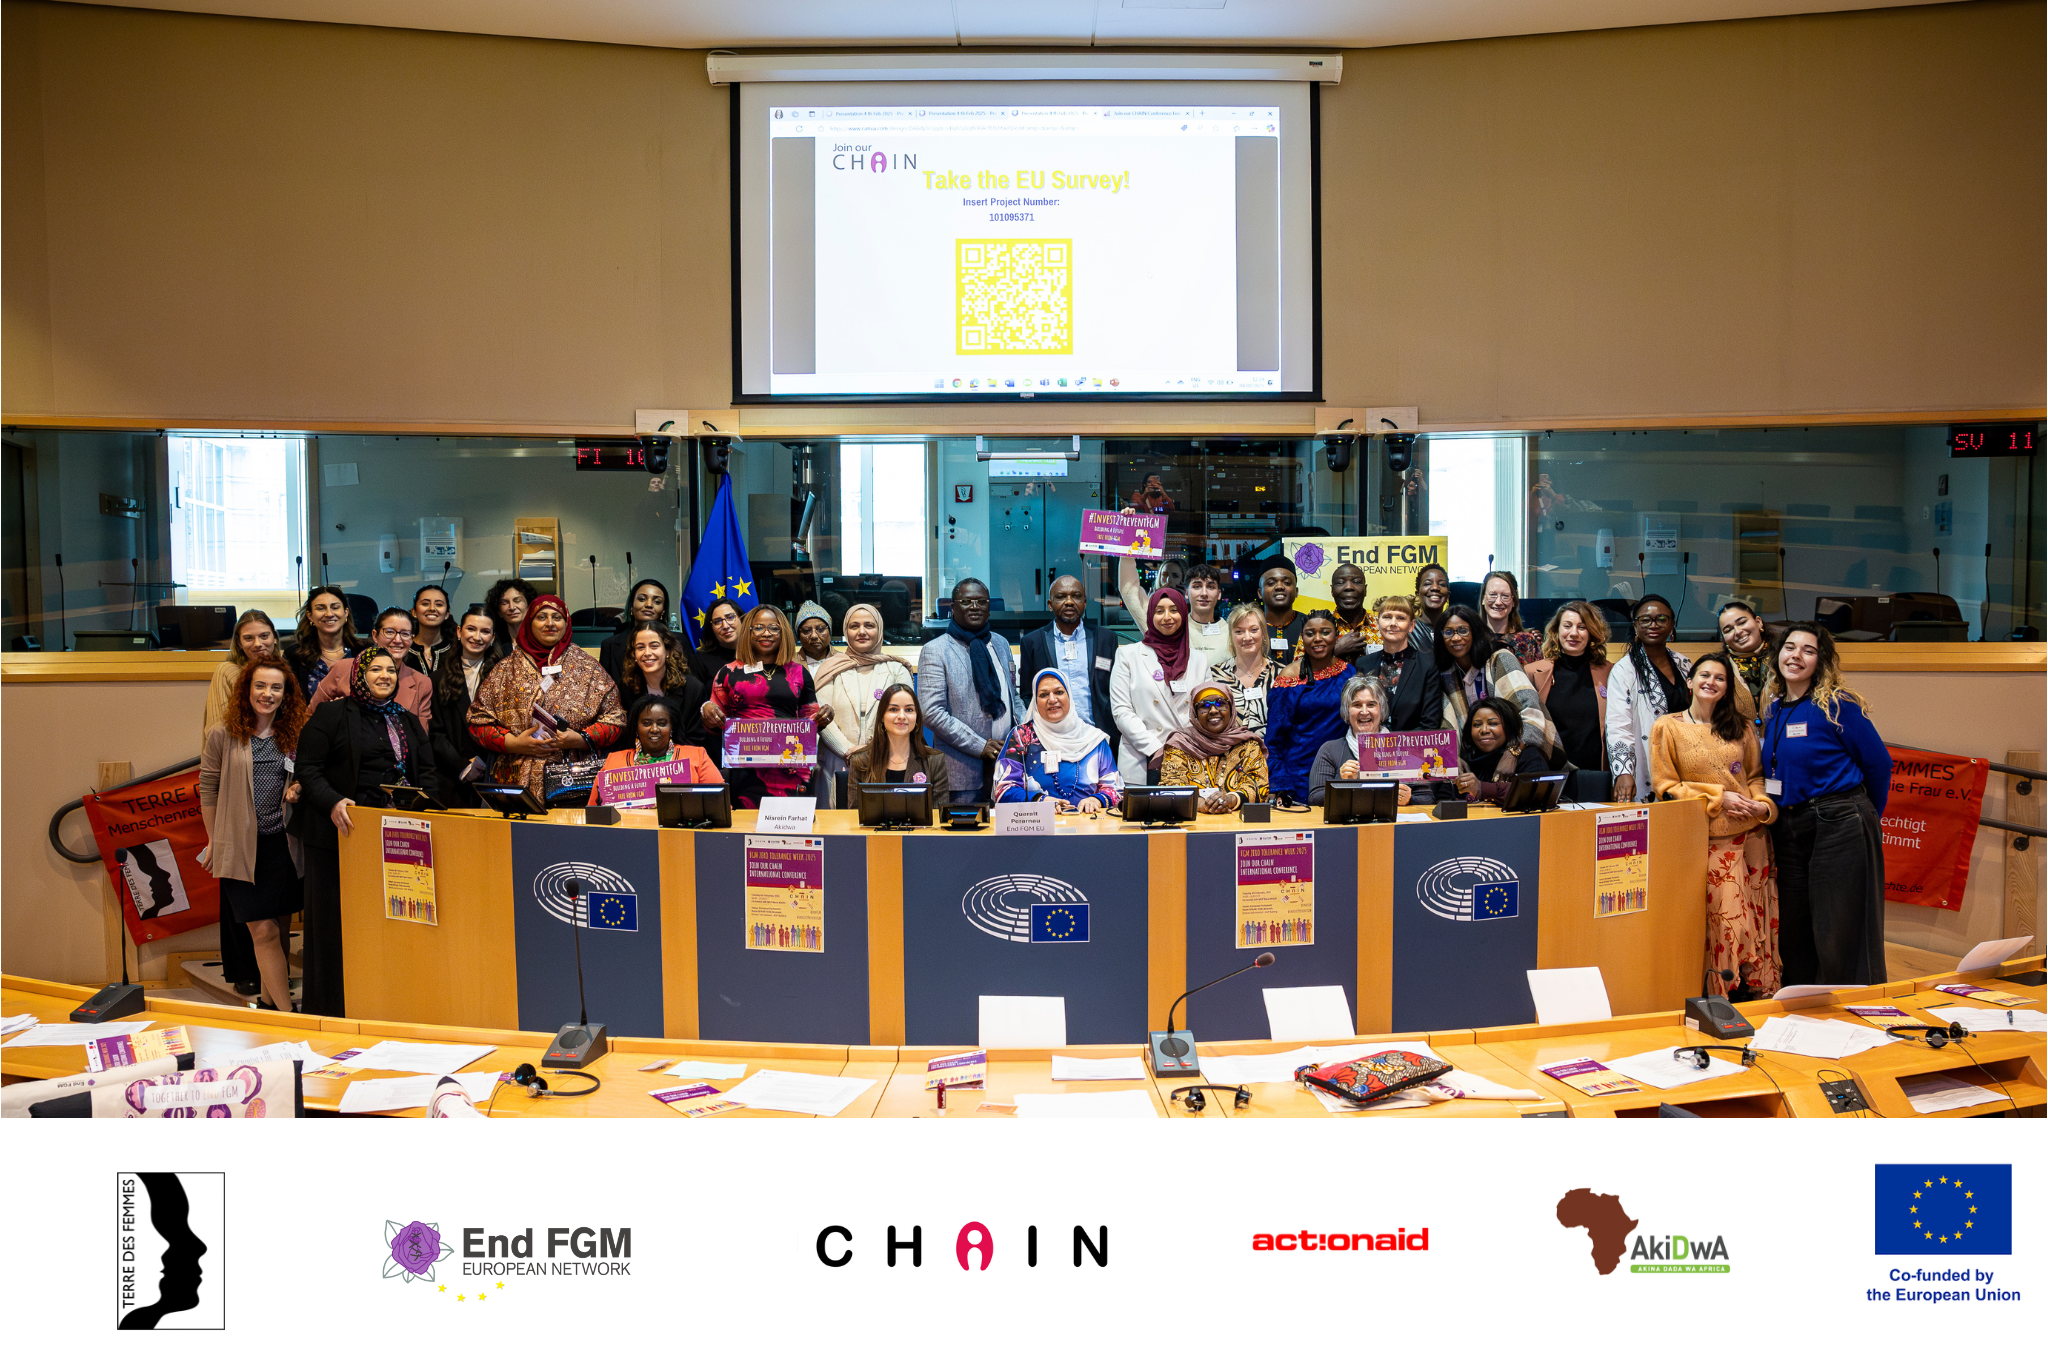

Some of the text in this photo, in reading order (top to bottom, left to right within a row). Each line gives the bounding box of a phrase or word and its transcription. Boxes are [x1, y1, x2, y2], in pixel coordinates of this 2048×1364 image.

[832, 143, 853, 152] Join
[832, 151, 917, 173] CHAIN
[922, 170, 1130, 194] Take the EU Survey!
[963, 197, 1060, 208] Insert Project Number:
[989, 213, 1035, 222] 101095371
[1955, 432, 2033, 450] SV 11
[578, 448, 602, 465] FI
[1337, 544, 1438, 564] End FGM
[1358, 566, 1424, 574] PEAN NETW
[1891, 760, 1955, 782] MMES
[1888, 780, 1971, 801] ie Frau e.V.
[122, 787, 189, 814] TERRE
[108, 805, 202, 837] Menschenrec
[1880, 816, 1927, 834] echtigt
[1882, 832, 1921, 850] timmt
[129, 877, 138, 890] DES
[1884, 882, 1924, 894] chte.de
[133, 890, 144, 911] TERRE
[152, 1086, 239, 1104] TOGETHER TO END FGM
